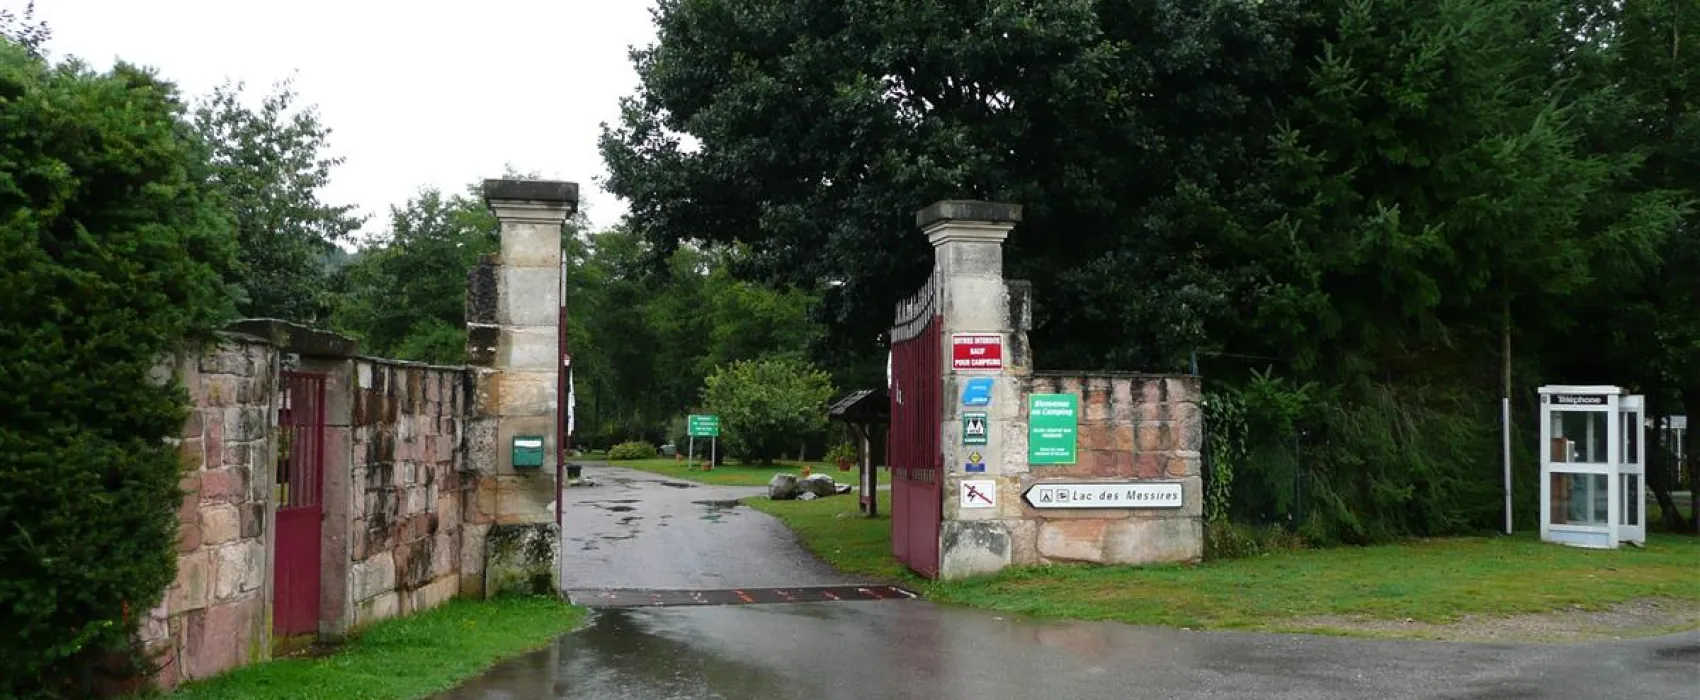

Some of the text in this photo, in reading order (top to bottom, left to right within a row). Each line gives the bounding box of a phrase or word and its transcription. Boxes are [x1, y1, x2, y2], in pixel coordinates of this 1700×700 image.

[970, 347, 986, 355] SAUF
[954, 359, 970, 367] POUR
[1033, 400, 1070, 408] Bienvenue
[1042, 408, 1073, 418] Camping
[1072, 489, 1179, 501] Lac des Messires
